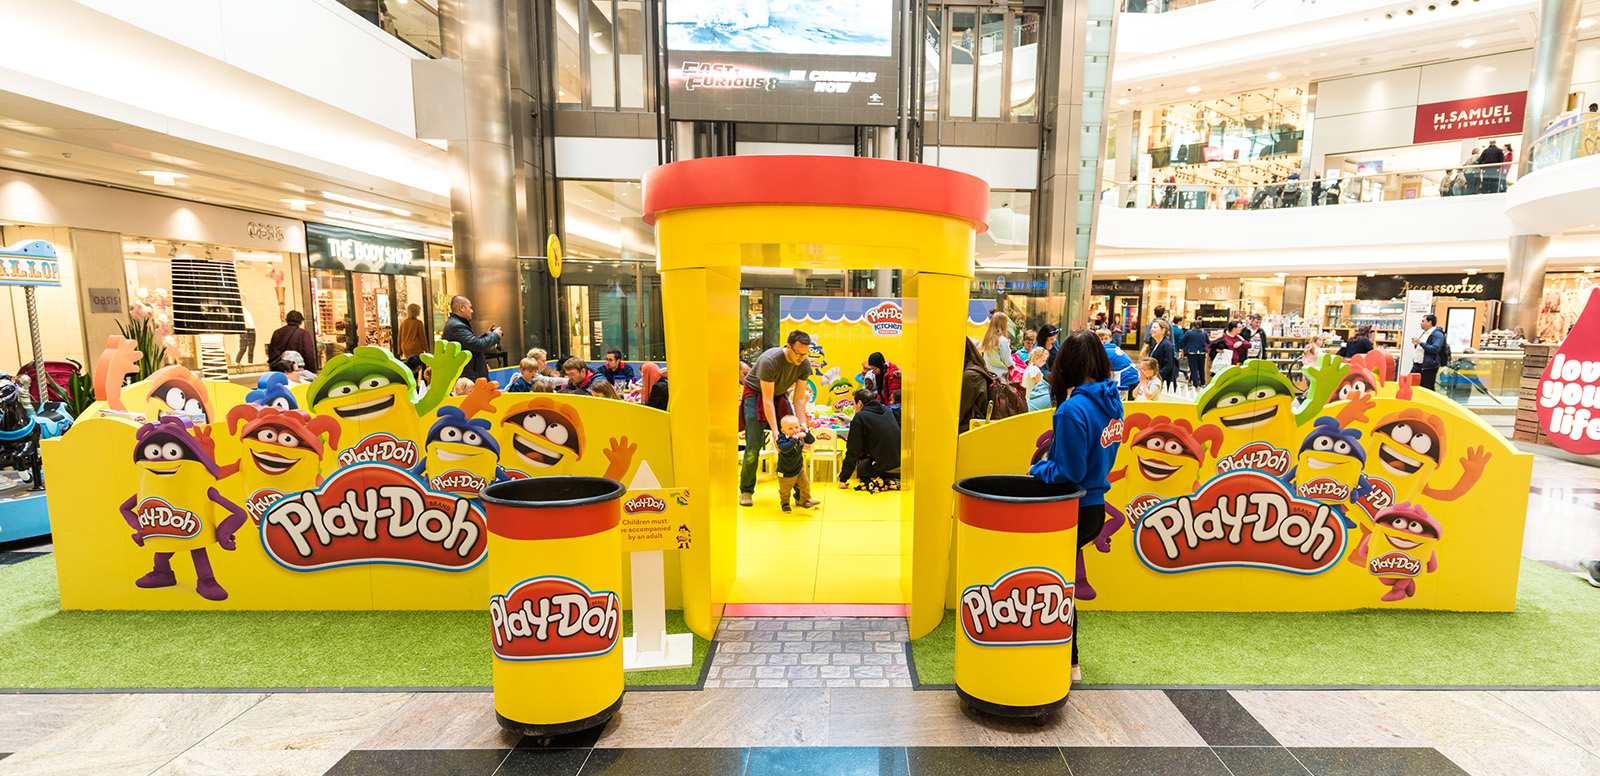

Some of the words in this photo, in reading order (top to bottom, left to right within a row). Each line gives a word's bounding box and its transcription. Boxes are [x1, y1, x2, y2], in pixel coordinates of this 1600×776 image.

[685, 76, 765, 91] FURIOUS
[808, 70, 877, 83] CINEMAS
[813, 82, 852, 93] NOW
[1433, 104, 1512, 124] H.SAMUEL
[1433, 123, 1453, 131] THE
[1457, 117, 1511, 129] JEWELLER
[327, 238, 353, 259] THE
[354, 240, 384, 263] BODY
[385, 245, 412, 265] SHOP
[1398, 277, 1484, 296] Accessorize
[93, 296, 119, 306] oasis
[339, 440, 414, 465] Play-Doh
[1217, 449, 1288, 471] Play-Doh
[432, 475, 486, 491] Play-Doh
[1298, 482, 1349, 498] Play-Doh
[429, 501, 451, 511] BRAND
[625, 497, 665, 511] Play-Doh
[1293, 506, 1313, 517] BRAND
[267, 485, 480, 558] Play-Doh
[628, 525, 671, 533] accompanied
[1143, 491, 1336, 563] Play-Doh
[1370, 557, 1420, 574] Play-Doh
[963, 583, 1073, 634] Play-Do
[490, 591, 618, 648] Play-Doh
